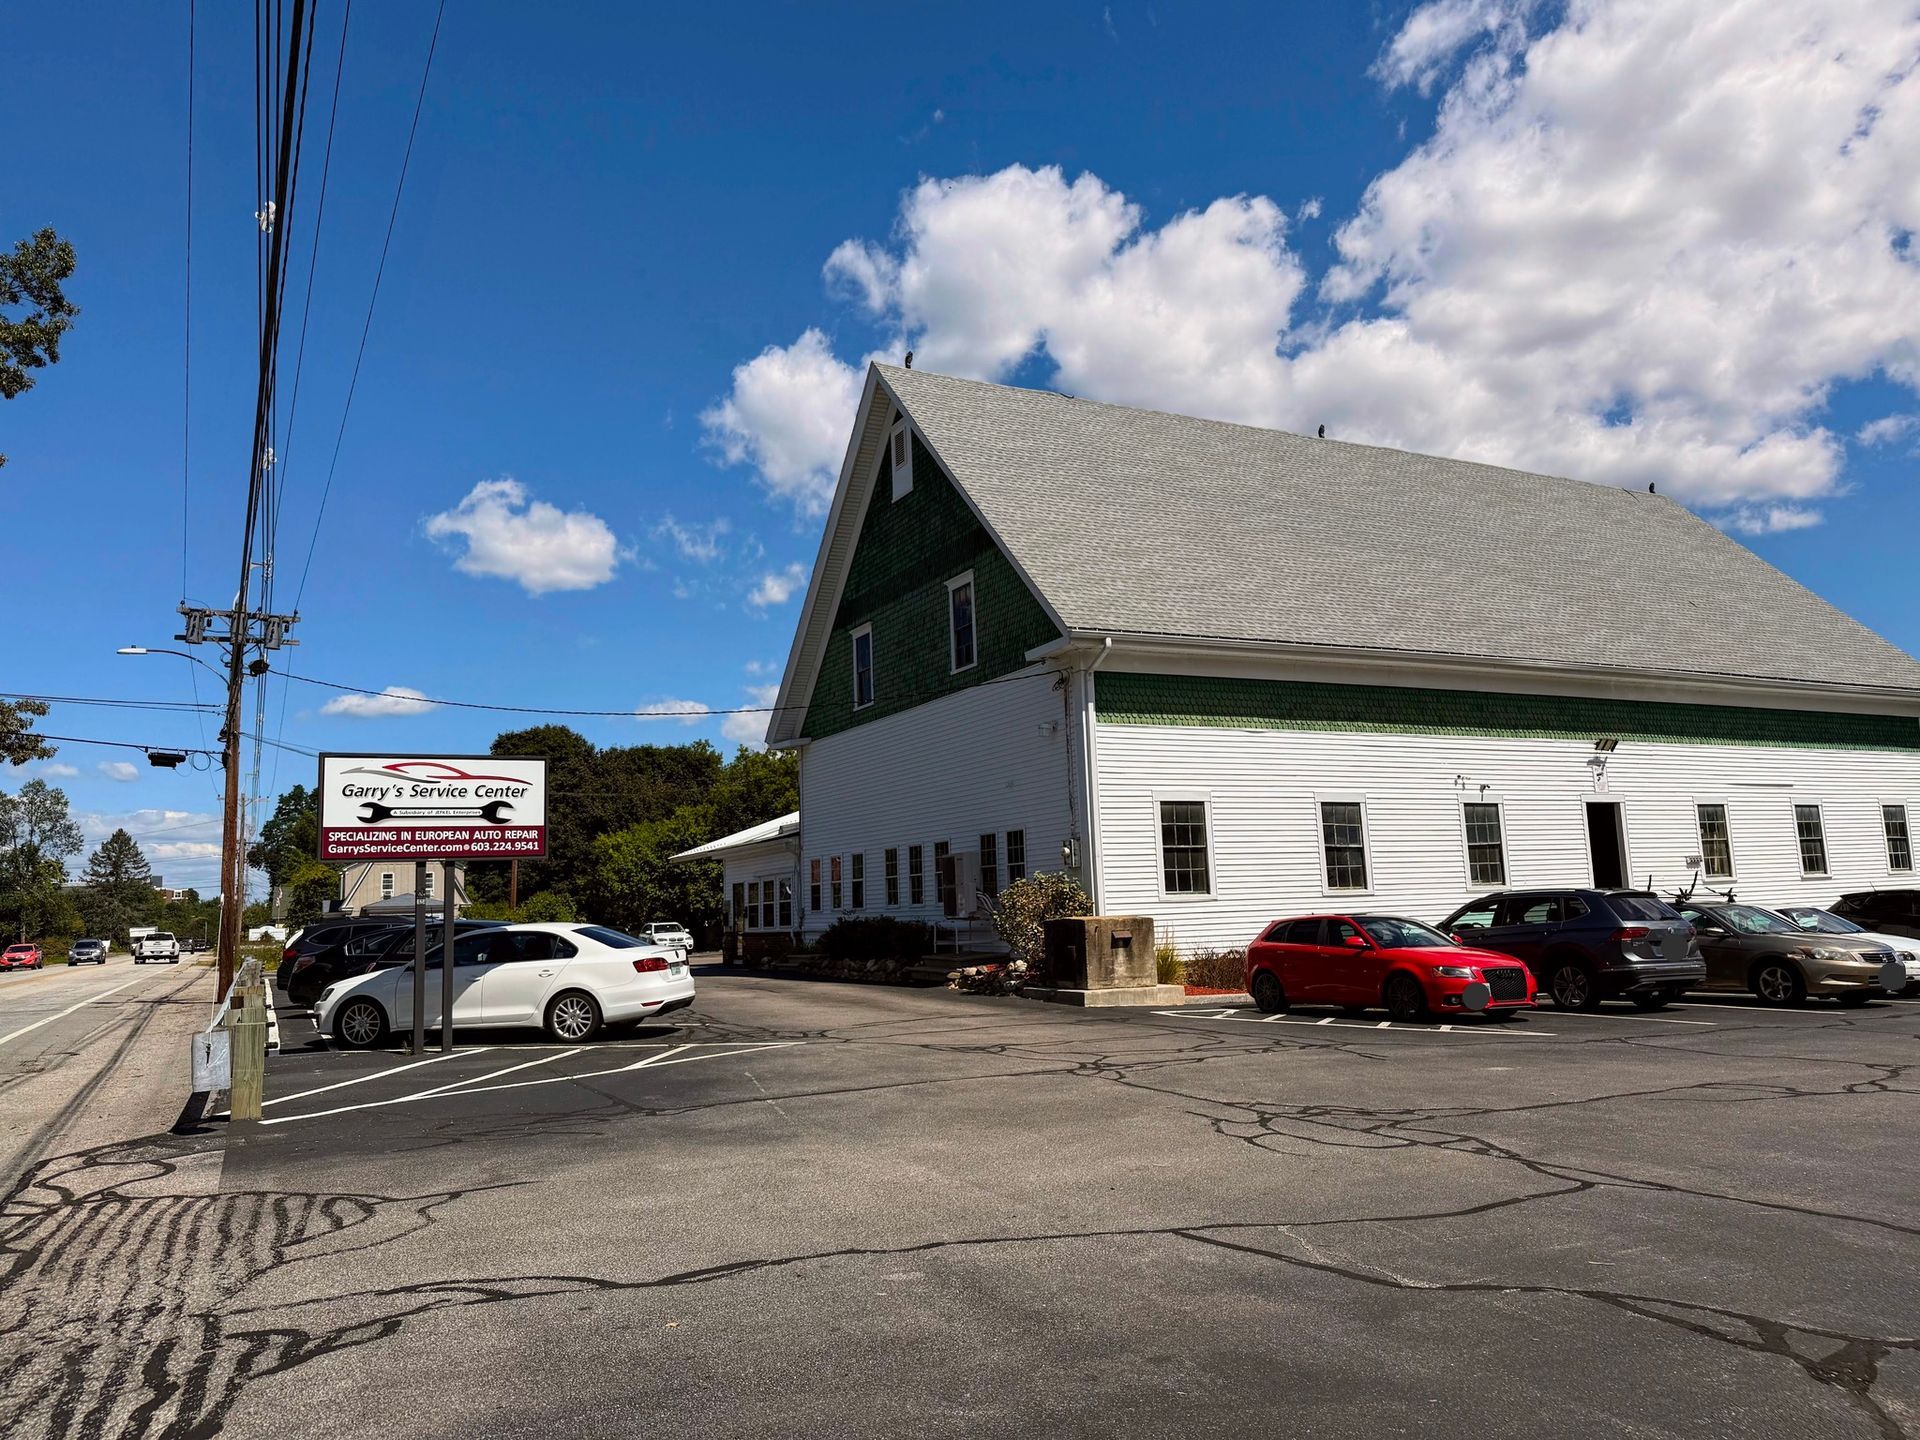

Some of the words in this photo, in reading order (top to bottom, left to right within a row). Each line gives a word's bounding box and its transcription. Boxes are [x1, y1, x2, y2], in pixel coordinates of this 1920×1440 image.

[342, 783, 404, 801] Garry's
[409, 783, 468, 798] Service
[474, 784, 528, 798] Center
[328, 831, 397, 842] SPECIALIZING
[400, 831, 412, 841] IN
[415, 831, 470, 841] EUROPEAN
[473, 830, 502, 840] AUTO
[505, 830, 539, 840] REPAIR
[471, 841, 540, 852] 603.224.9541
